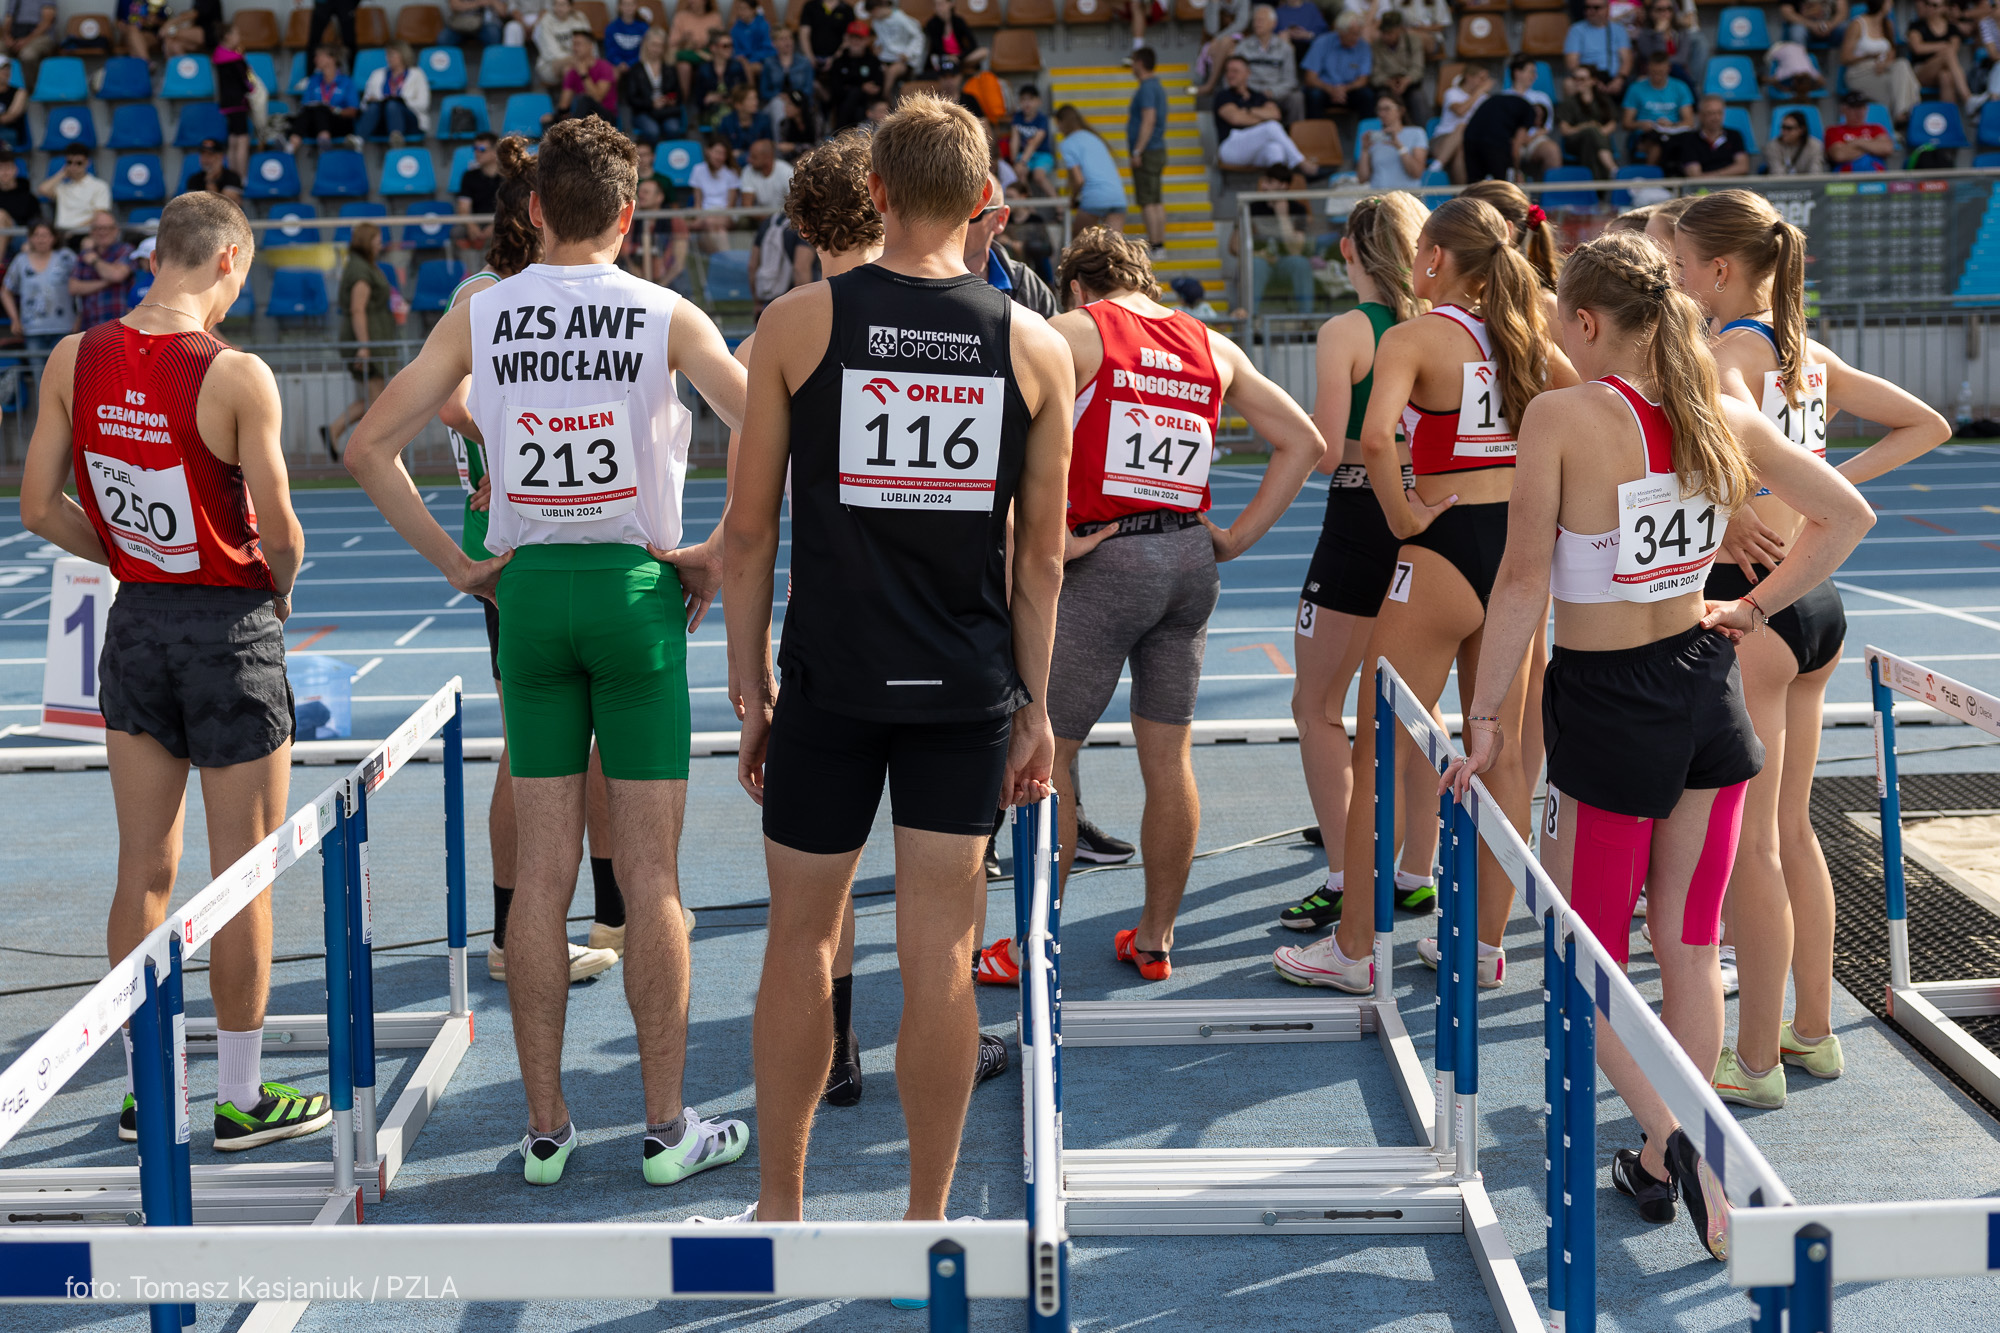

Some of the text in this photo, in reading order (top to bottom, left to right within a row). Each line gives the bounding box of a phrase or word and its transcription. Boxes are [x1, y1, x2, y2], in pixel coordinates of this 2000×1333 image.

[492, 304, 646, 345] AZS AWF
[900, 329, 981, 346] POLITECHNIKA
[900, 341, 981, 364] OPOLSKA
[1140, 347, 1183, 372] BKS
[492, 350, 643, 386] WROCŁAW
[125, 389, 146, 406] KS
[907, 384, 984, 405] ORLEN
[1113, 369, 1212, 405] BYDGOSZCZ
[97, 405, 168, 428] CZEMPION
[1478, 391, 1505, 428] 1
[548, 411, 614, 432] ORLEN
[1155, 414, 1201, 433] ORLEN
[98, 423, 172, 444] WARSZAWA
[865, 413, 979, 470] 116
[1125, 432, 1200, 476] 147
[1485, 444, 1510, 453] LUBLIN
[519, 438, 618, 488] 213
[856, 477, 896, 486] MISTRZOSTWA
[574, 495, 604, 503] SZTAFETACH
[604, 490, 634, 500] MIESZANYCH
[881, 492, 952, 504] LUBLIN 2024
[1134, 487, 1179, 500] LUBLIN 2024
[105, 486, 177, 542] 250
[541, 506, 602, 517] LUBLIN 2024
[1591, 534, 1620, 550] WL
[1634, 504, 1716, 565] 341
[1394, 563, 1410, 593] 7
[1649, 573, 1699, 593] LUBLIN 2024
[1300, 601, 1313, 630] 3
[64, 594, 95, 698] 1
[1548, 794, 1557, 834] 8
